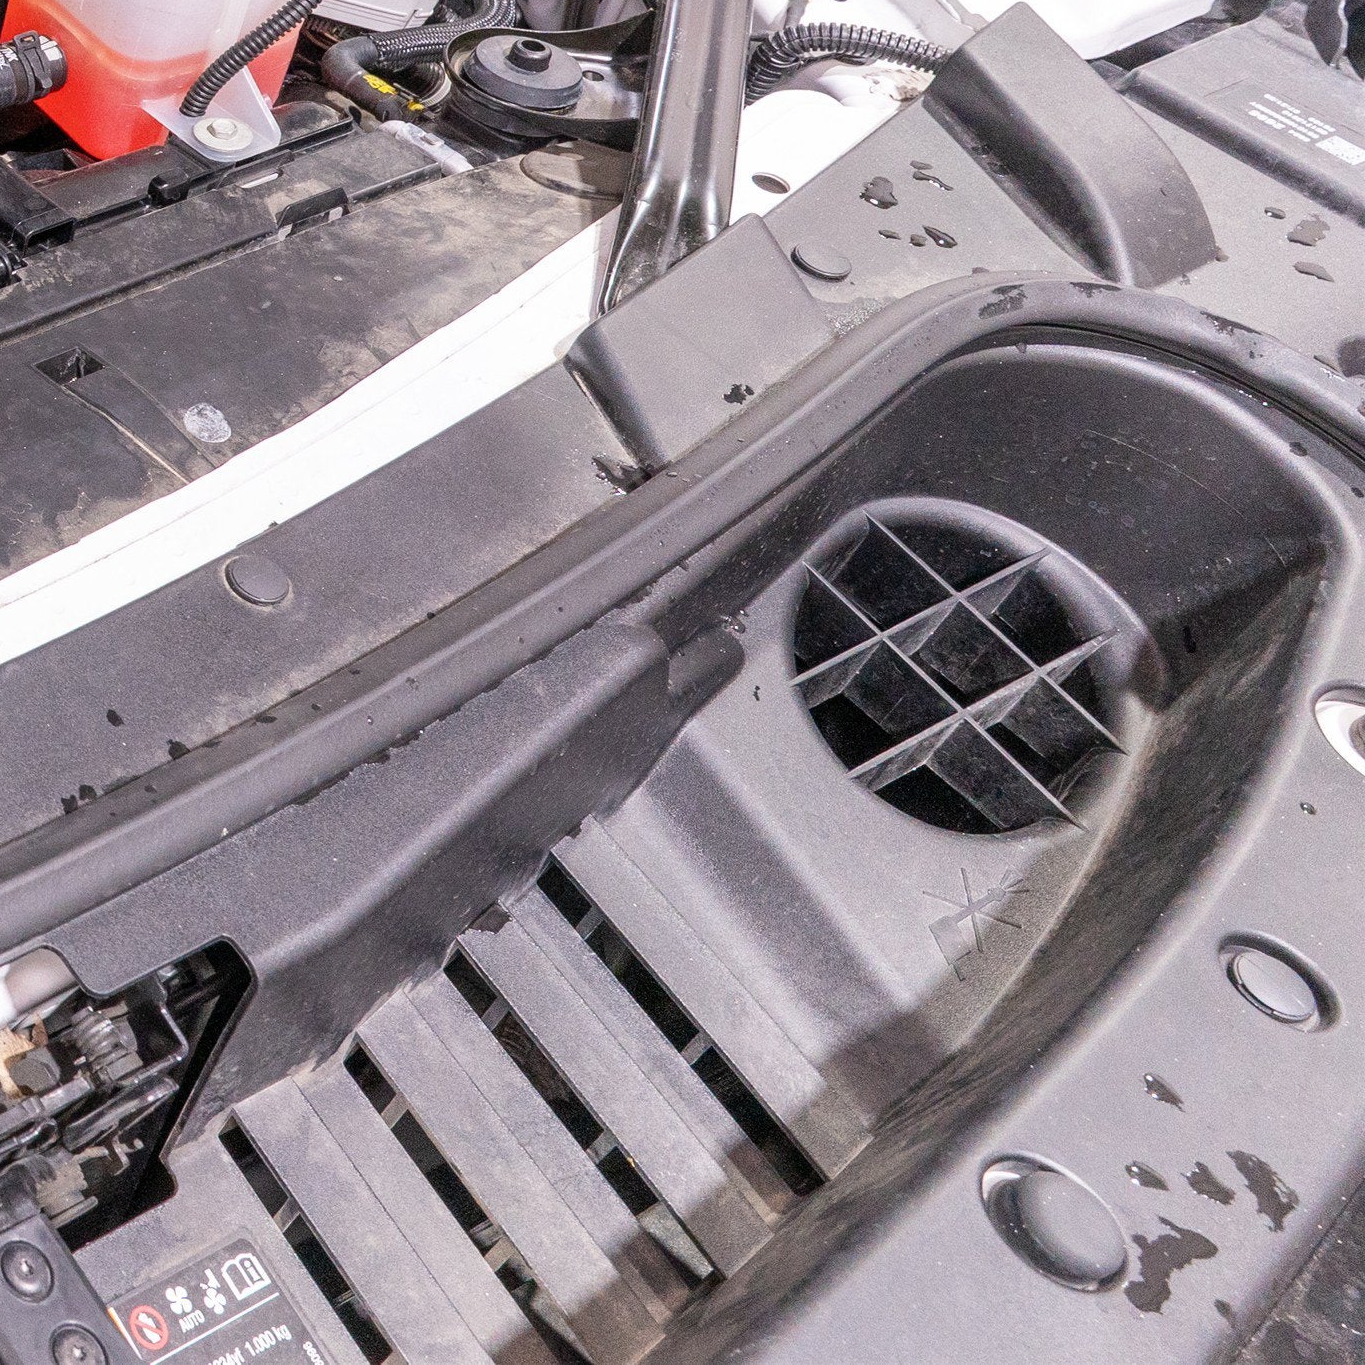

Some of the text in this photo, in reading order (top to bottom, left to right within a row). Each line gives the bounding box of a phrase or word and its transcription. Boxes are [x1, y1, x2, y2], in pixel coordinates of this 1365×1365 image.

[178, 1309, 206, 1333] AUTO
[244, 1330, 277, 1357] 1.000
[271, 1324, 292, 1341] kg
